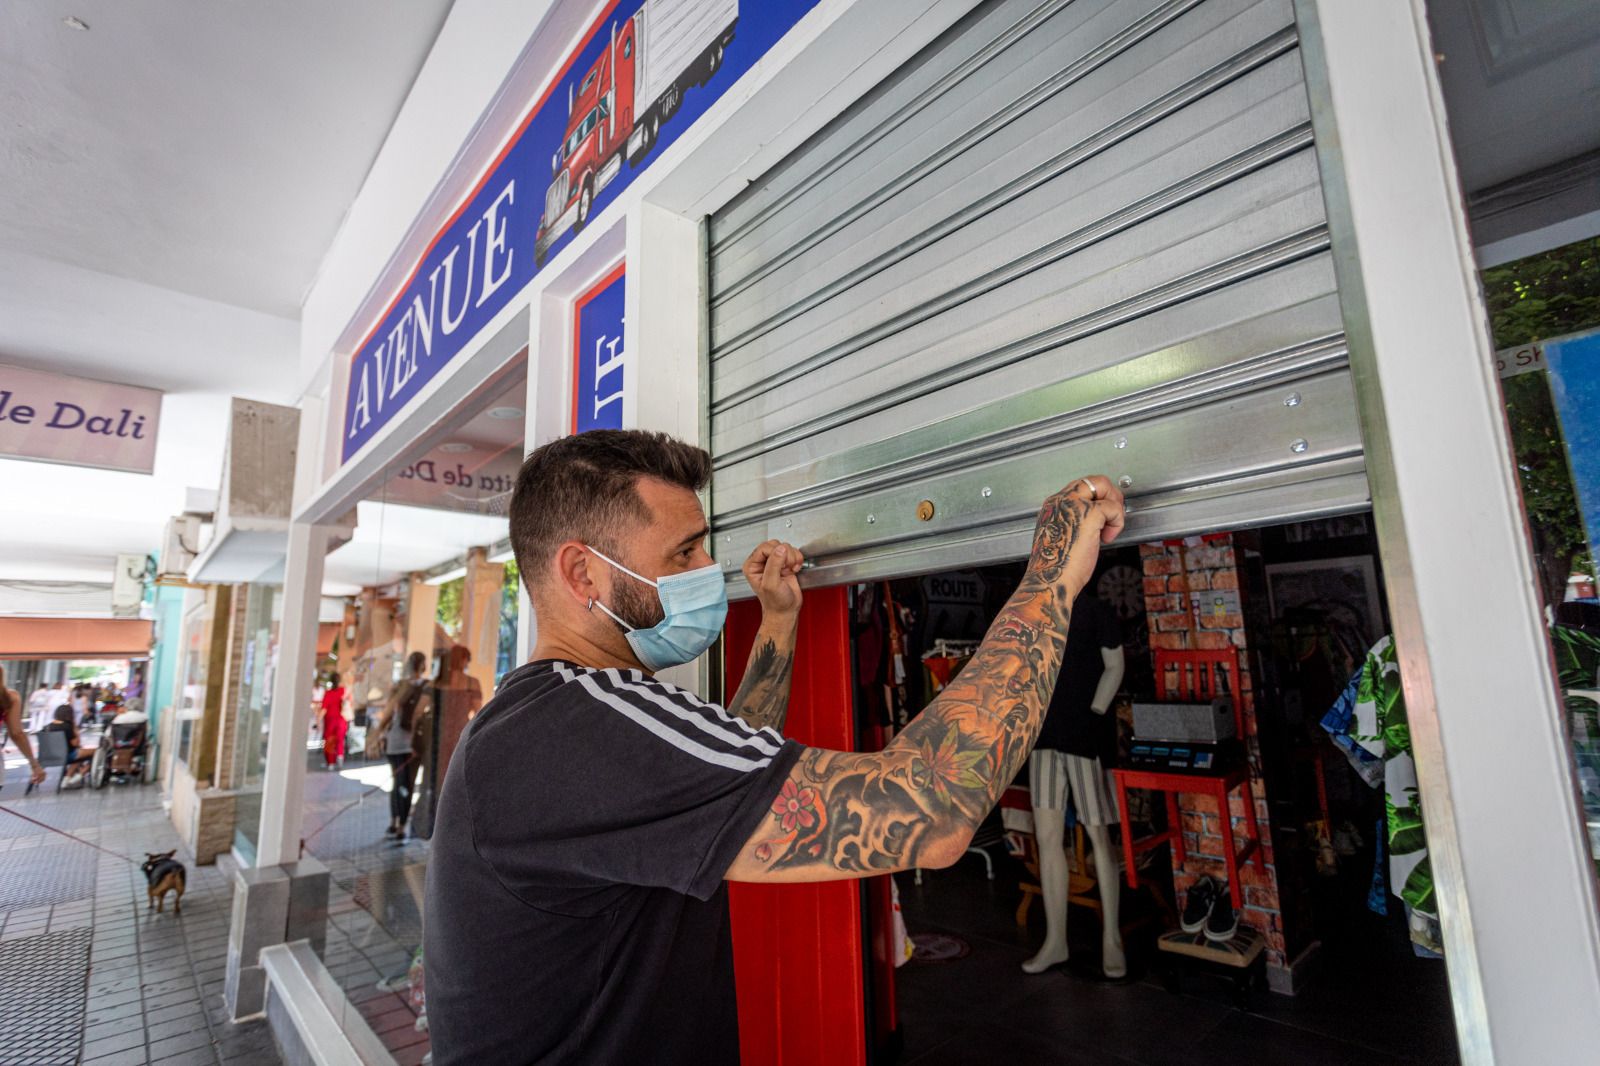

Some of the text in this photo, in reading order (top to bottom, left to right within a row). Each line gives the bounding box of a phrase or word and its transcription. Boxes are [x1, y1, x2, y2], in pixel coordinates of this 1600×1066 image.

[349, 179, 515, 438] AVENUE
[45, 402, 146, 439] Dali
[931, 578, 977, 598] ROUTE
